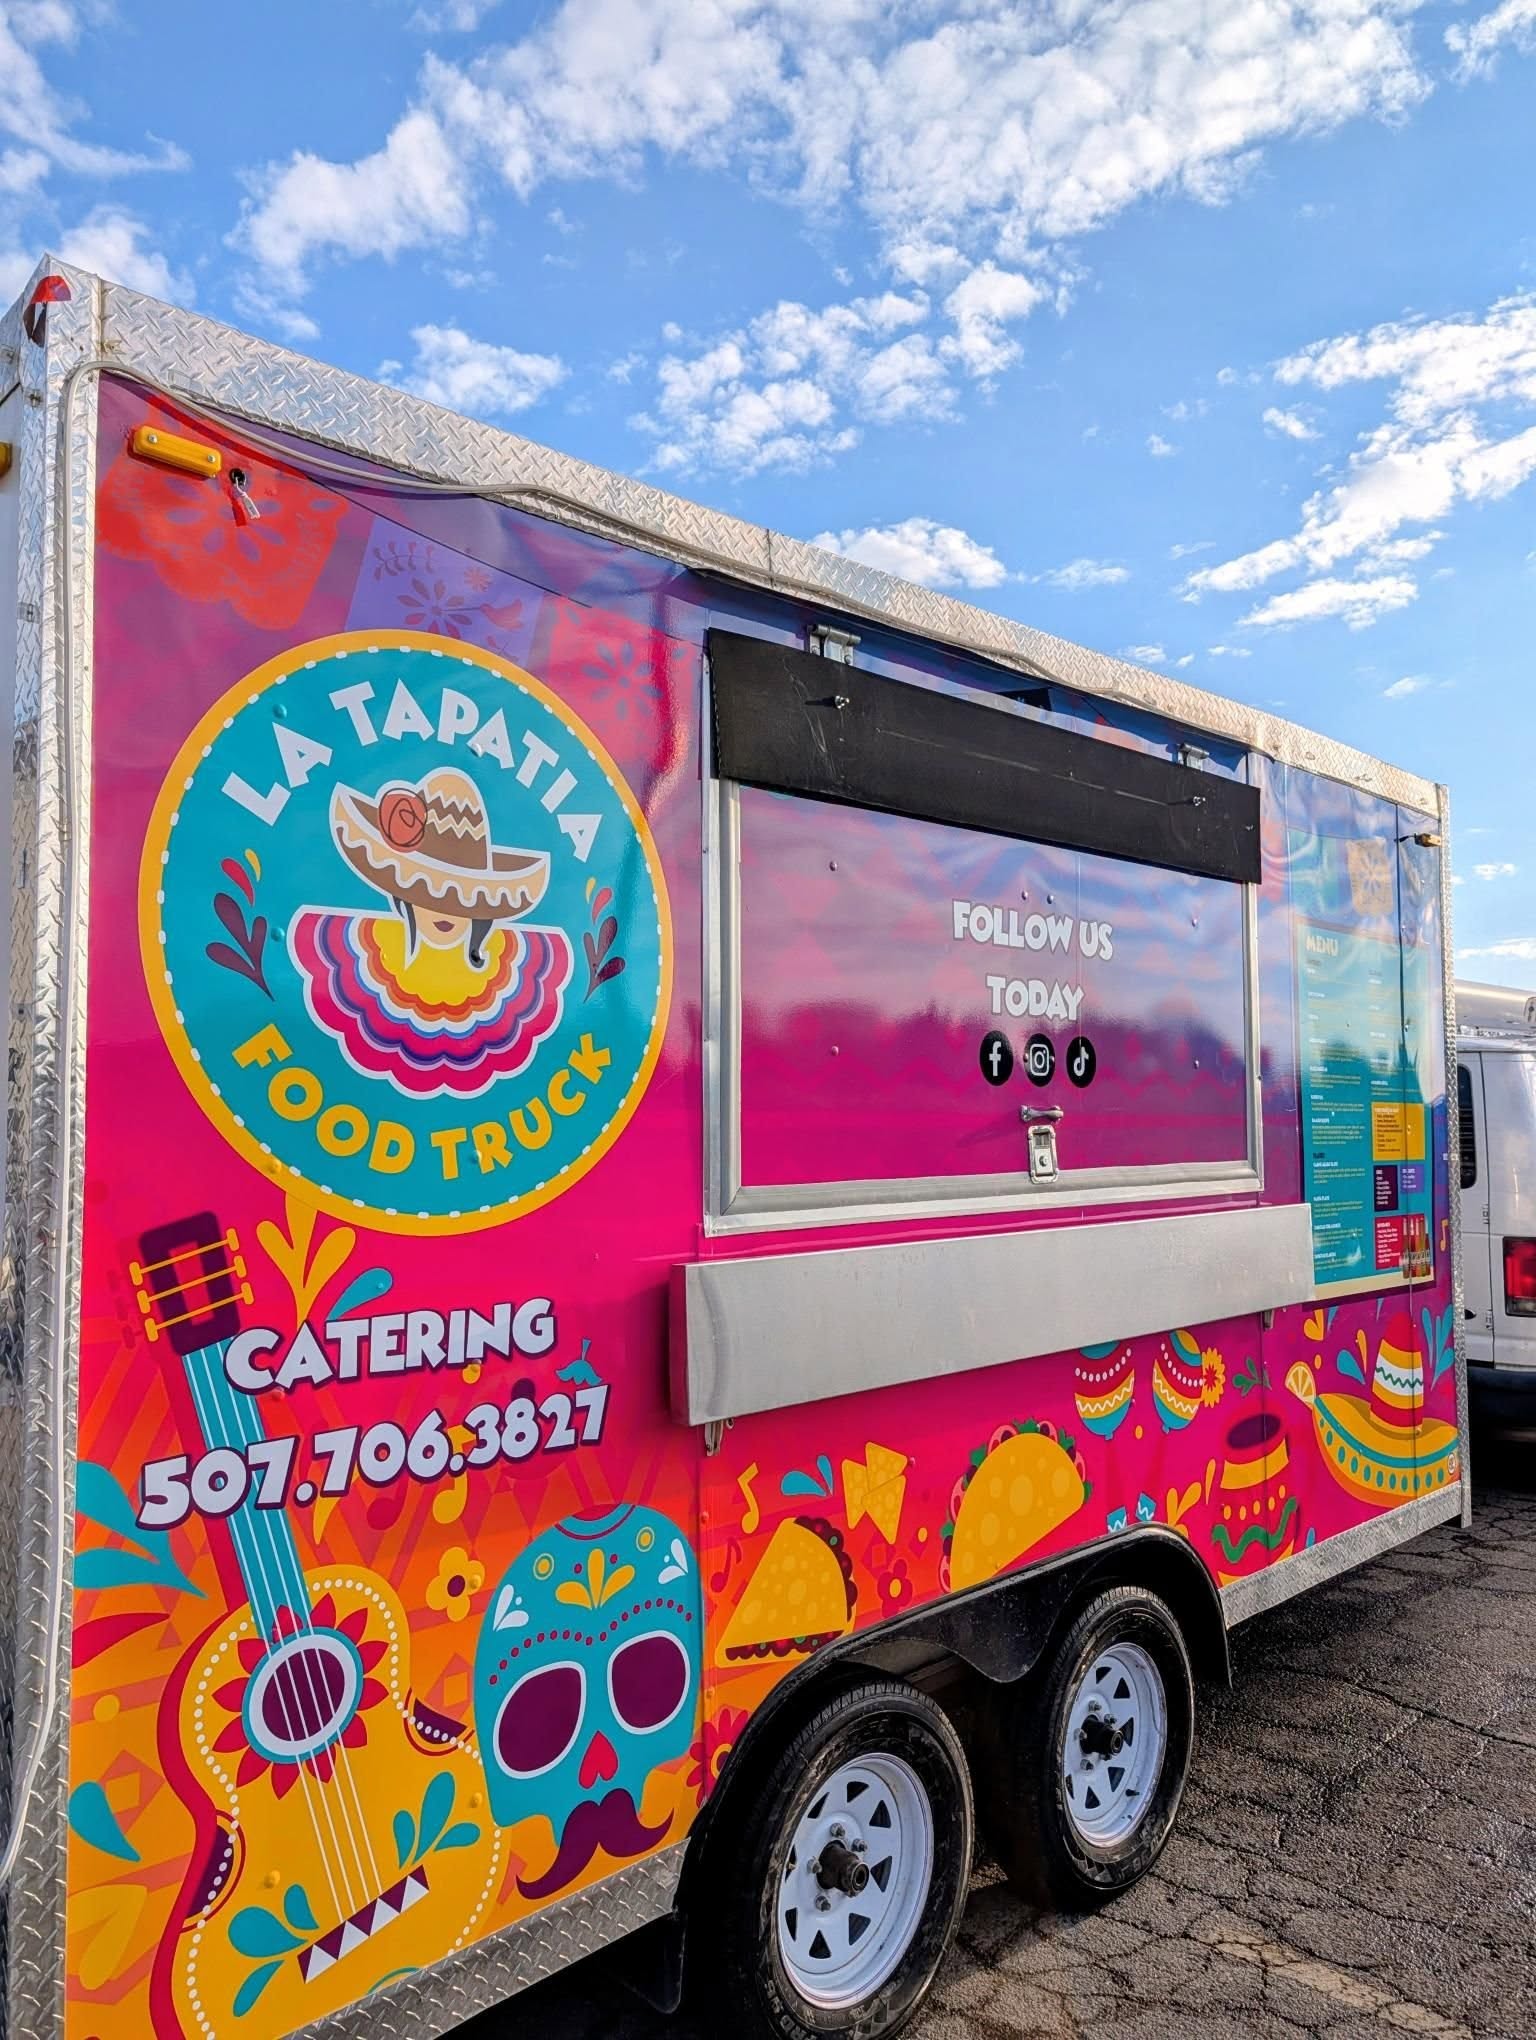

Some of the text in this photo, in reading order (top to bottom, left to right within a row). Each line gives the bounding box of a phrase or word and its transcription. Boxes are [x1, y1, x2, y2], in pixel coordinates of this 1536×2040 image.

[221, 678, 602, 862] LA TAPATIA
[952, 899, 1114, 961] FOLLOW US
[1306, 935, 1339, 957] MENU
[986, 975, 1085, 1021] TODAY
[232, 1023, 611, 1180] FOOD TRUCK
[225, 1298, 556, 1392] CATERING
[137, 1384, 609, 1528] 507.706.3827
